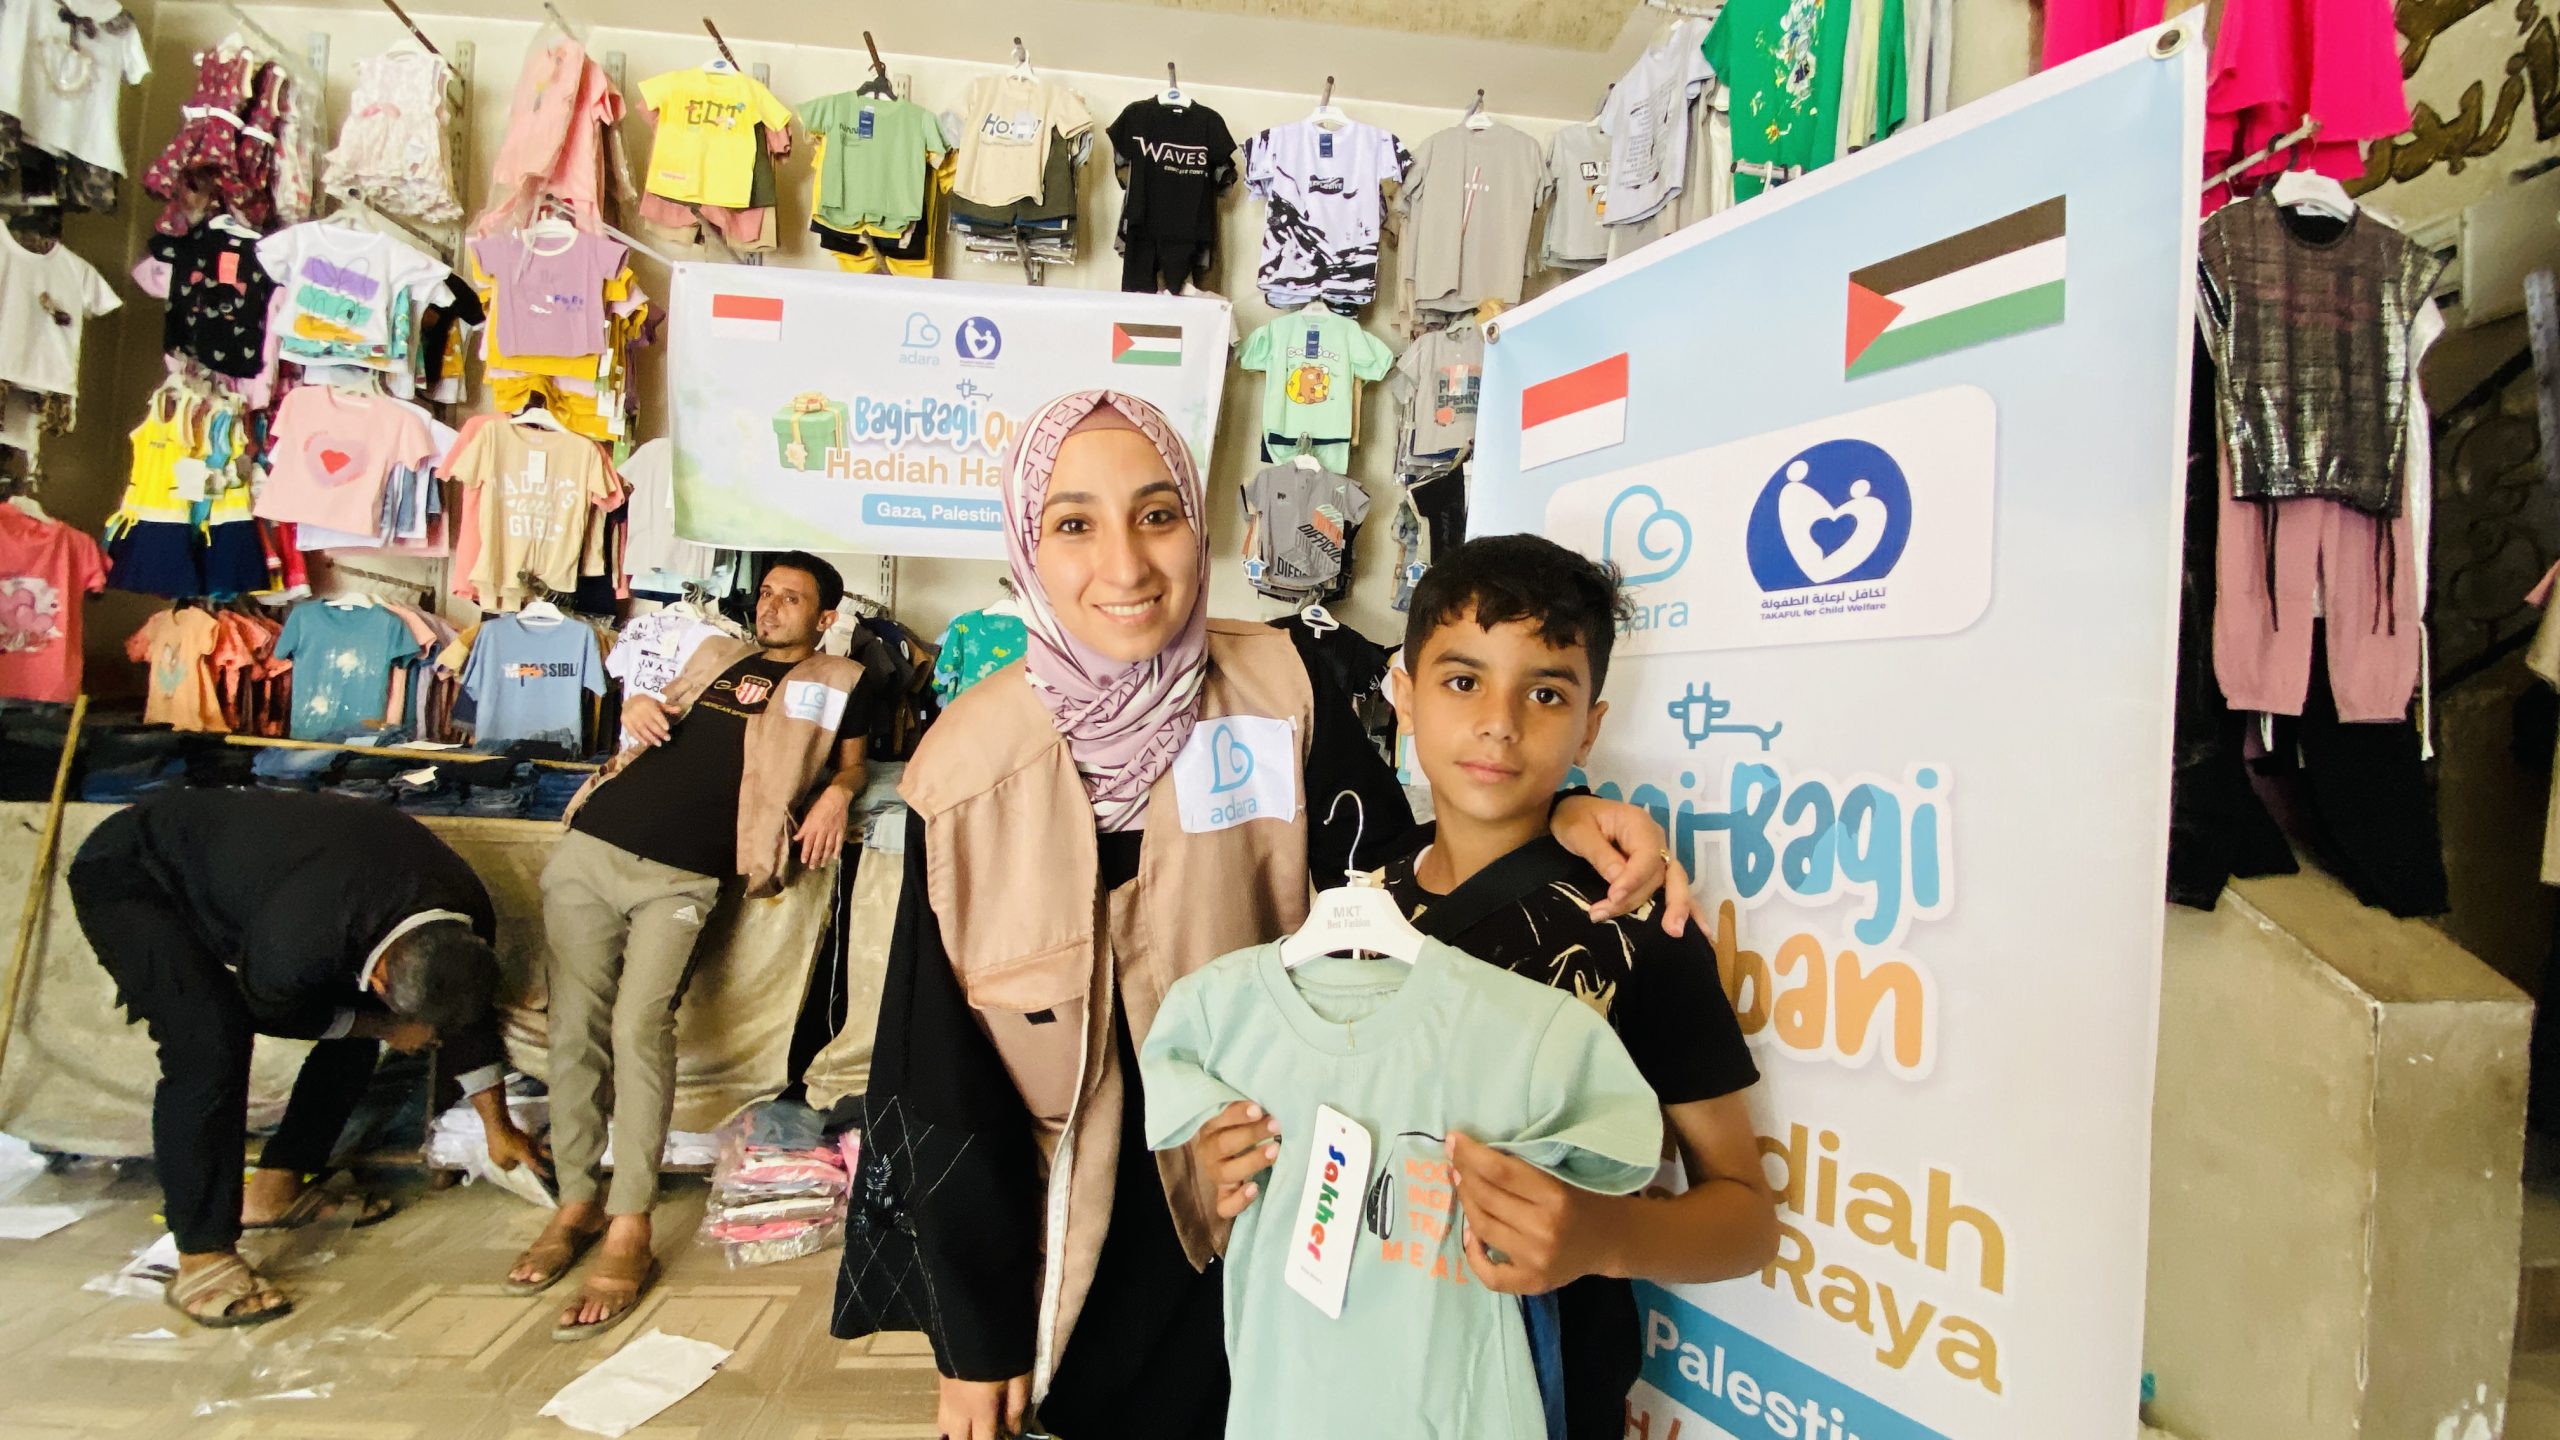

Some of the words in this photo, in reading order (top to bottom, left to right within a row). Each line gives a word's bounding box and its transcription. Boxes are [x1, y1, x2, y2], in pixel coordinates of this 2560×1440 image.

[1132, 136, 1209, 166] WAVES
[899, 350, 941, 367] adara
[855, 396, 977, 446] Bagi-Bagi
[826, 449, 948, 484] Hadiah
[959, 457, 1003, 487] Ha
[876, 502, 927, 521] Gaza,
[931, 504, 1003, 523] Palestin
[1760, 611, 1801, 621] TAKAFUL
[1803, 608, 1816, 617] for
[1818, 605, 1844, 615] Child
[1847, 601, 1887, 612] Welfare
[1210, 795, 1258, 825] adara
[1333, 905, 1362, 918] MKT
[1714, 898, 1924, 1069] ban
[1307, 1144, 1346, 1262] Sakher
[1756, 1121, 2006, 1296] diah
[1761, 1218, 2003, 1396] Raya
[1646, 1309, 1861, 1440] Palesti
